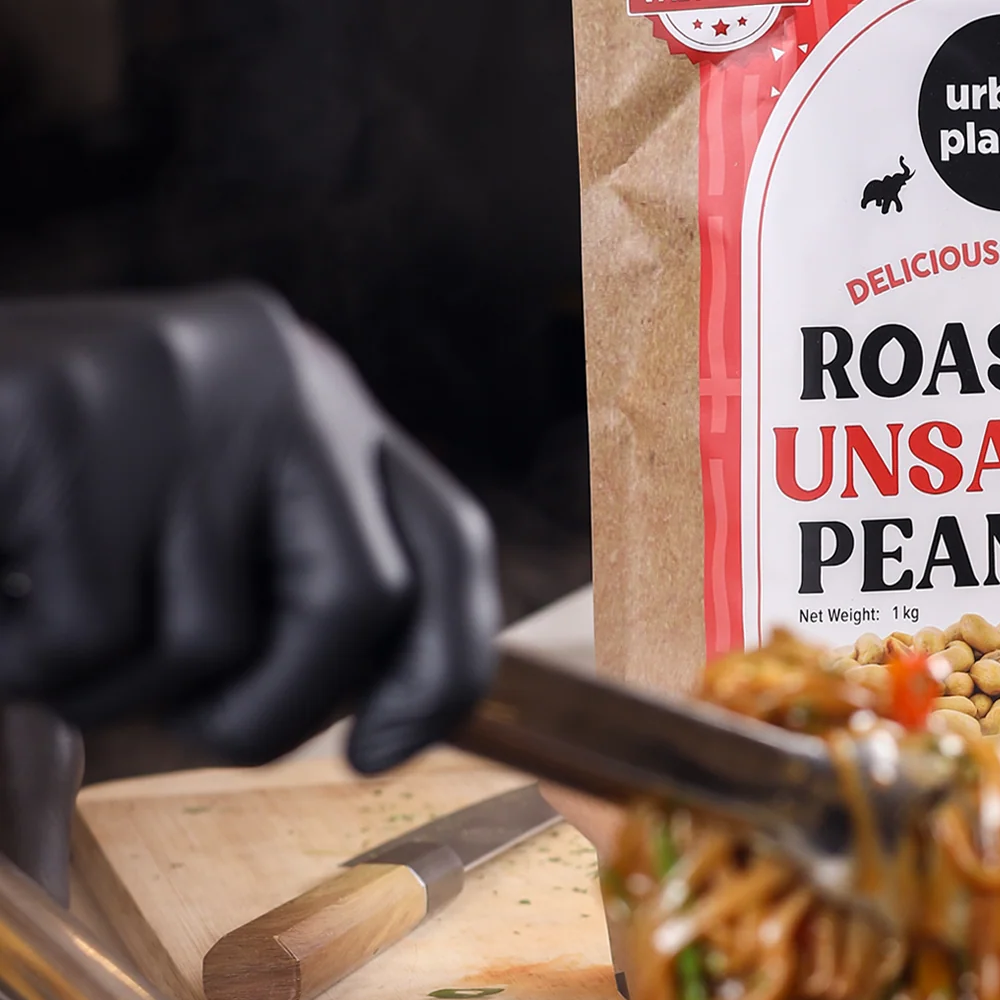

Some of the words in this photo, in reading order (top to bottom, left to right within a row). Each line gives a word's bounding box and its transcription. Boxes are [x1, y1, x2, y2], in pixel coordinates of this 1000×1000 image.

[845, 239, 999, 306] DELICIOUS
[799, 608, 824, 623] Net
[828, 607, 880, 626] Weight:
[892, 605, 899, 620] 1
[903, 605, 920, 623] kg
